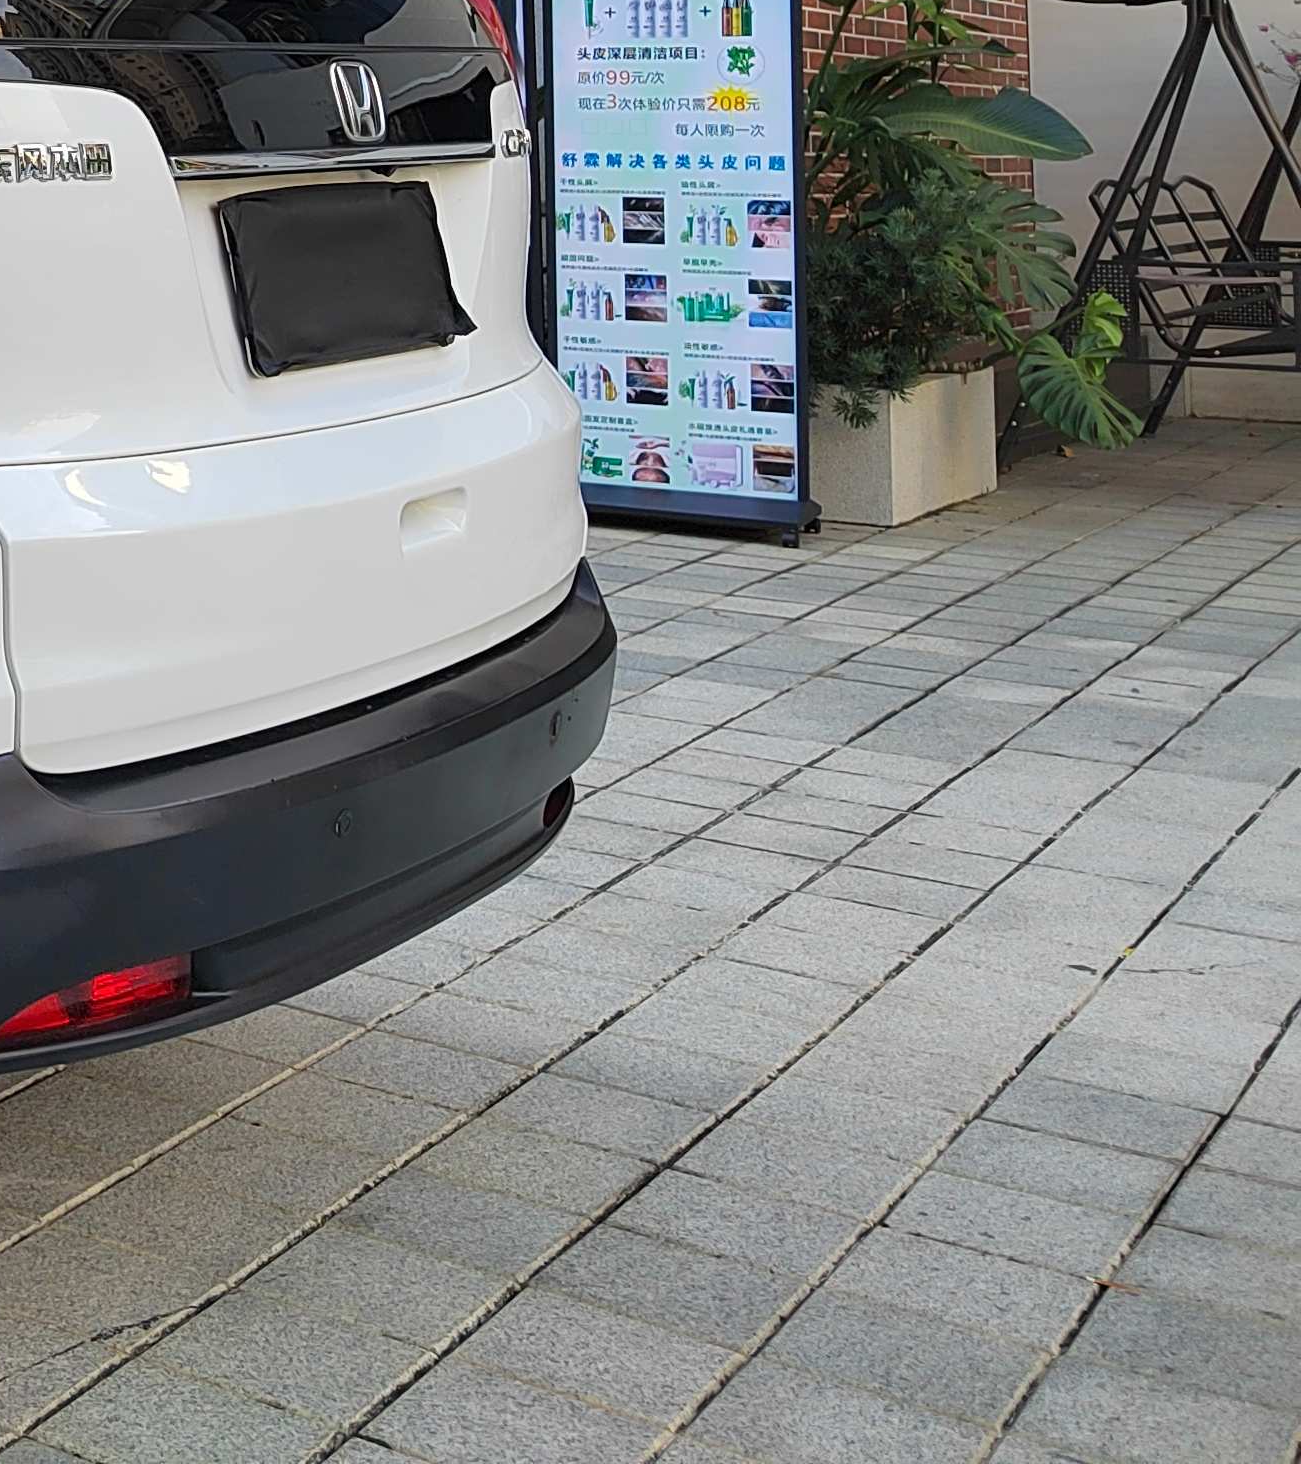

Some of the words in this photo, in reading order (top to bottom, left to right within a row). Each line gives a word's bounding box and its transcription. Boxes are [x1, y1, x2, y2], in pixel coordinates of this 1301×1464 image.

[577, 70, 665, 85] 原价99元/次
[676, 123, 765, 137] 每人限购一次
